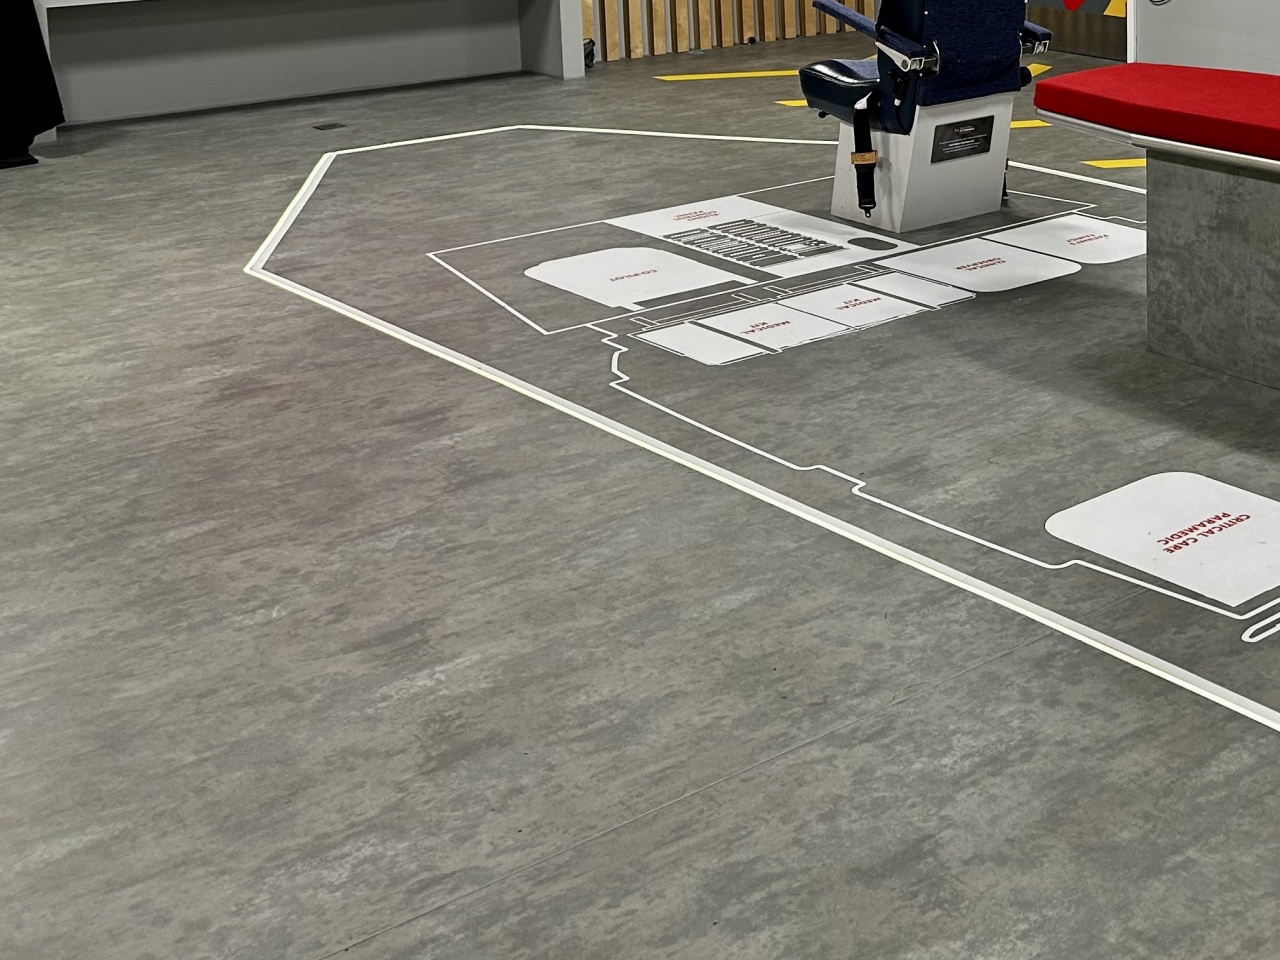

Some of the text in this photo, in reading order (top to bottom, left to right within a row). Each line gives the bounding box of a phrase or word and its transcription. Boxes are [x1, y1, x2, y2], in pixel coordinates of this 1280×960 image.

[609, 269, 657, 282] CO-PILOT
[835, 297, 881, 310] MEDICAL
[740, 320, 790, 334] MEDICAL
[1157, 512, 1231, 545] PARAMEDIC
[1162, 514, 1250, 553] CRITICAL CARE
